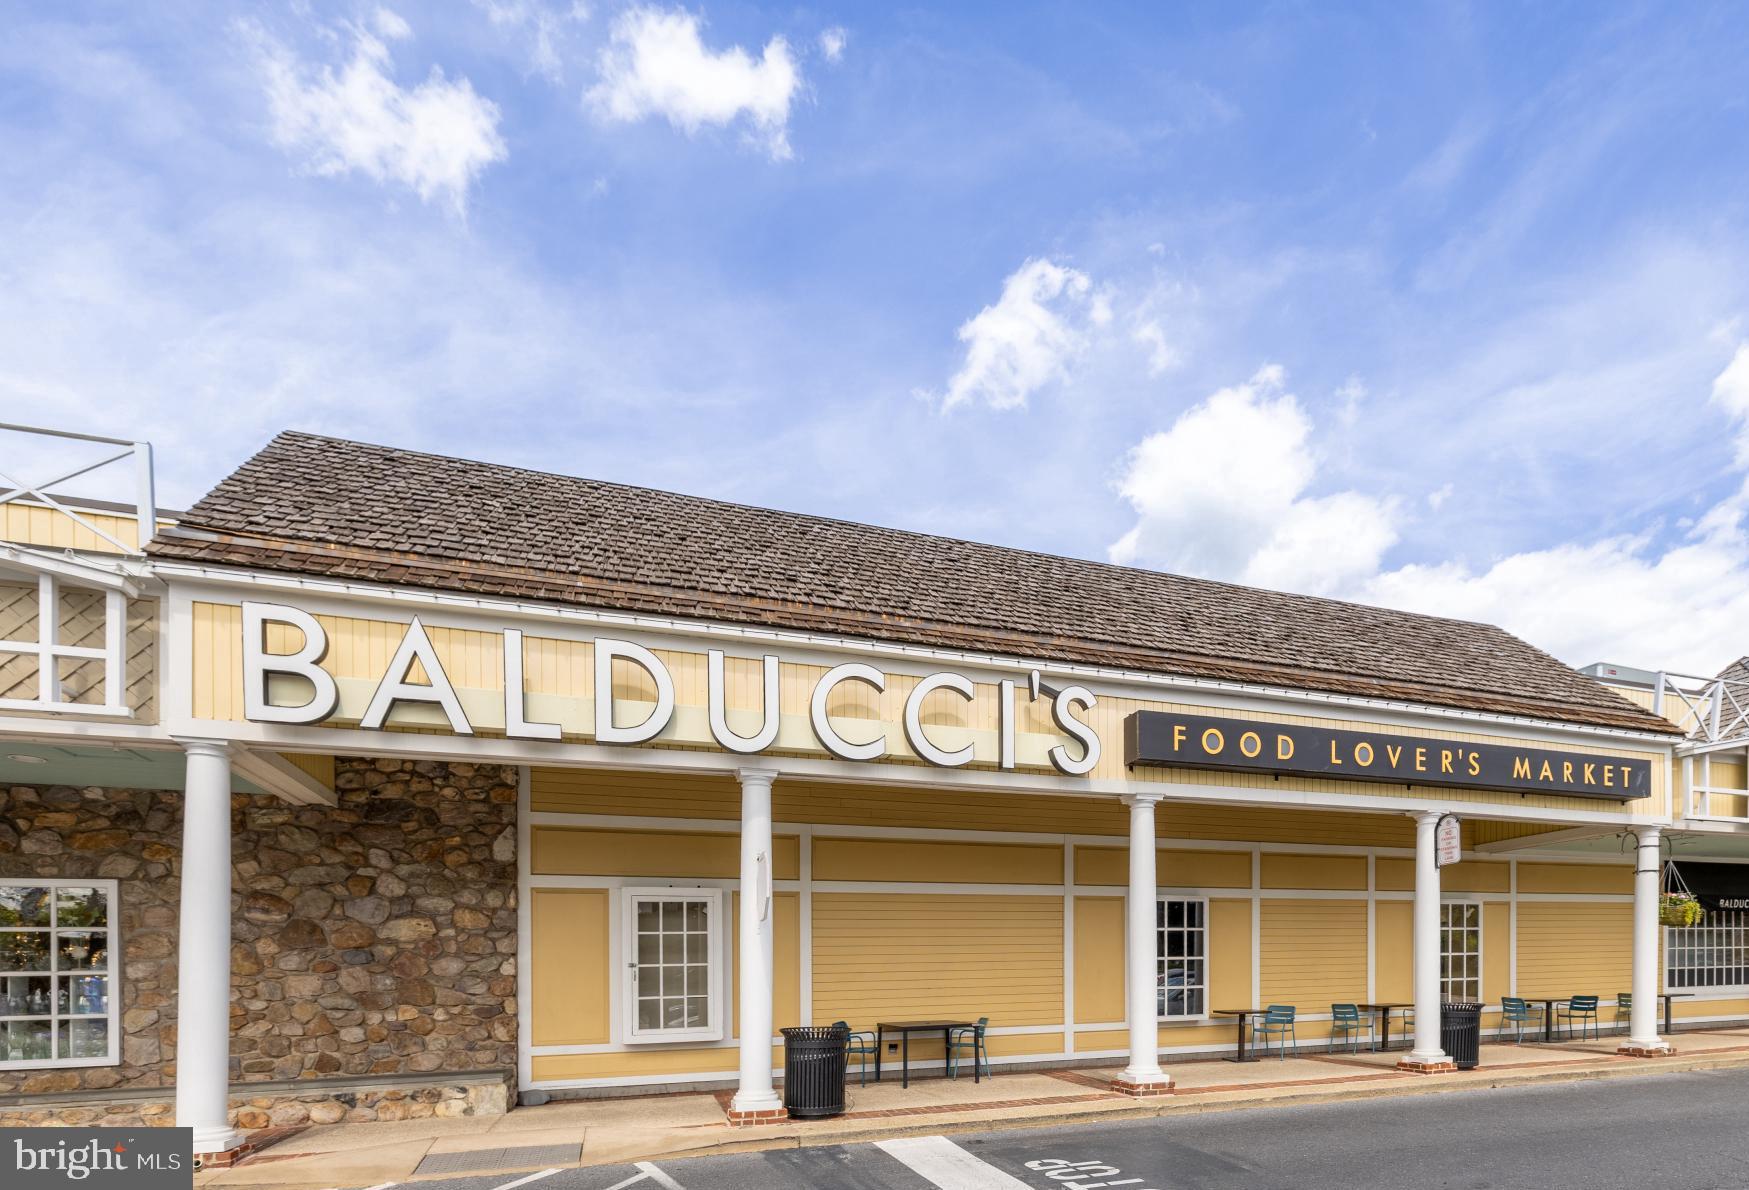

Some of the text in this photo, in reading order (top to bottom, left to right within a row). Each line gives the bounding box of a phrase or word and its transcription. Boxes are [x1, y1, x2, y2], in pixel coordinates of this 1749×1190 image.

[240, 600, 1101, 777] BALDUCCI'S
[1173, 725, 1632, 788] FOOD LOVER'S MARKET
[1024, 1158, 1160, 1190] TOP
